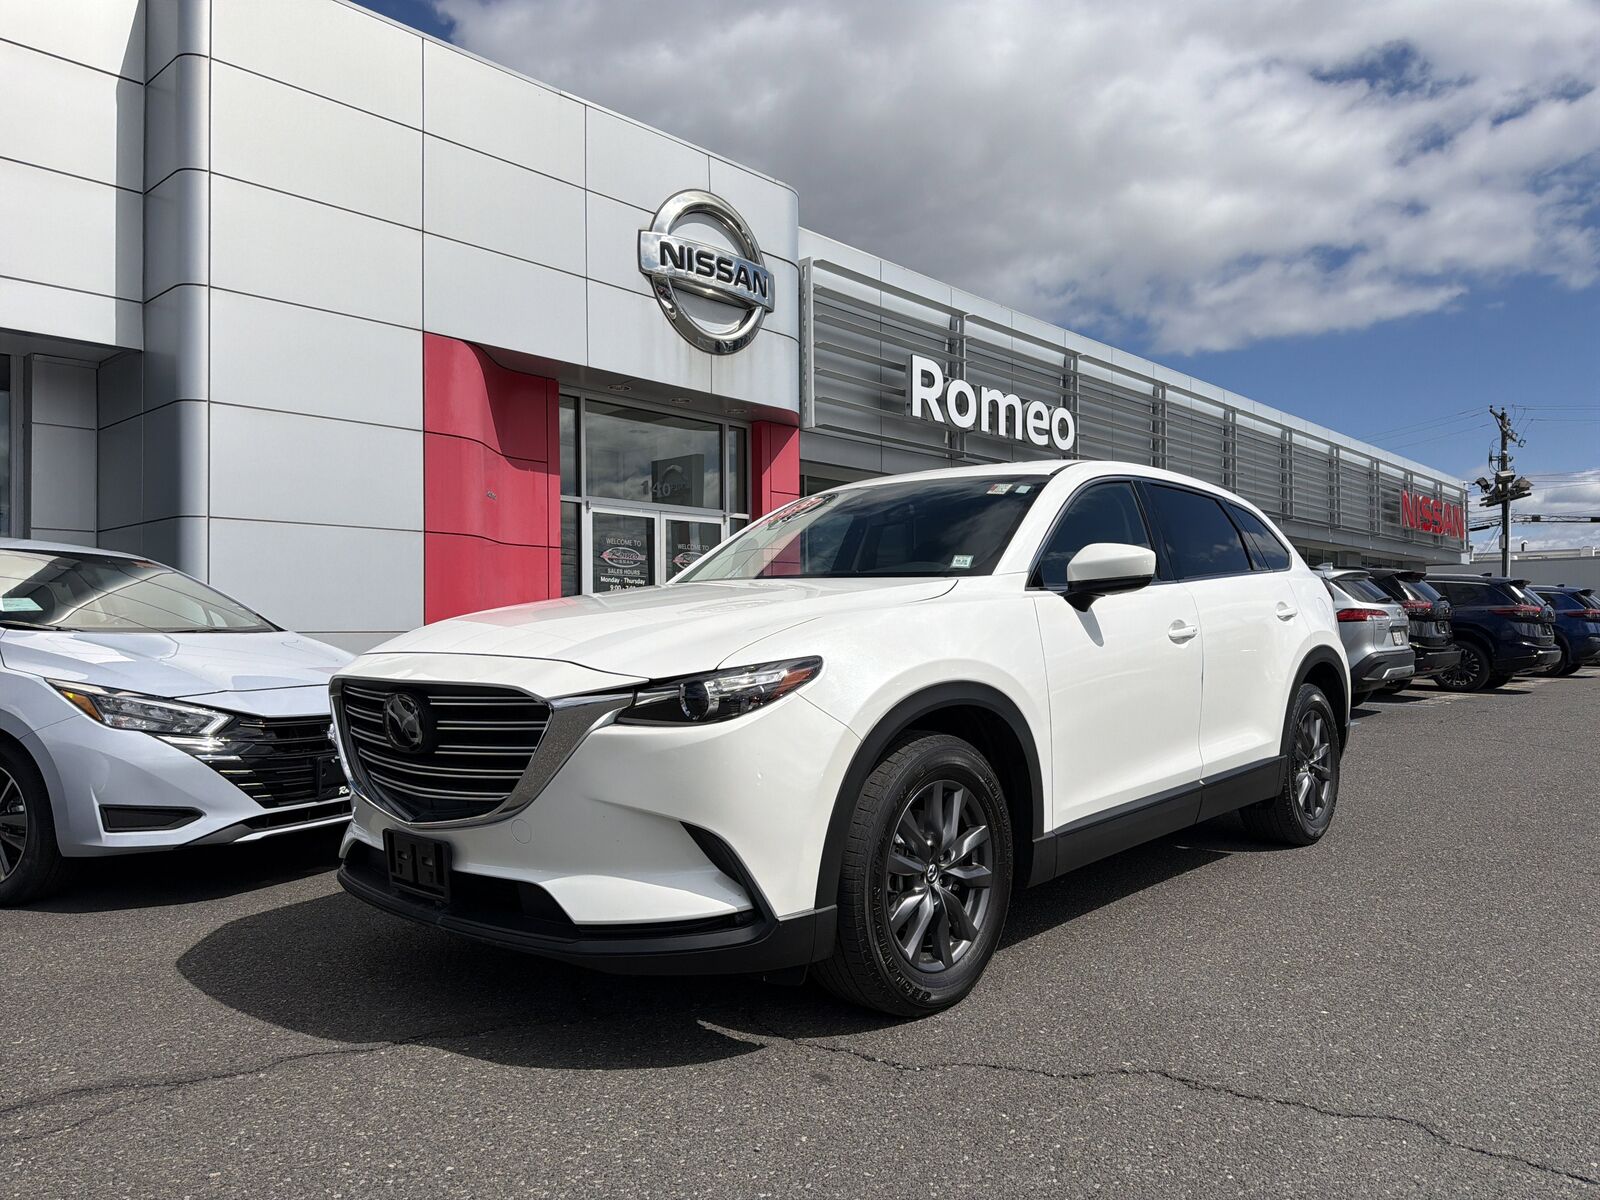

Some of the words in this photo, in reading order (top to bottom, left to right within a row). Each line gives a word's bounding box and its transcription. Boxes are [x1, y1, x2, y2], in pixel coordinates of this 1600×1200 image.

[659, 240, 768, 299] NISSAN
[909, 354, 1075, 450] Romeo
[640, 480, 670, 498] 140
[1401, 489, 1465, 541] NISSAN
[606, 537, 632, 546] WELCOME
[677, 543, 701, 551] WELCOME
[600, 576, 620, 584] Monday
[623, 577, 646, 585] Thursday
